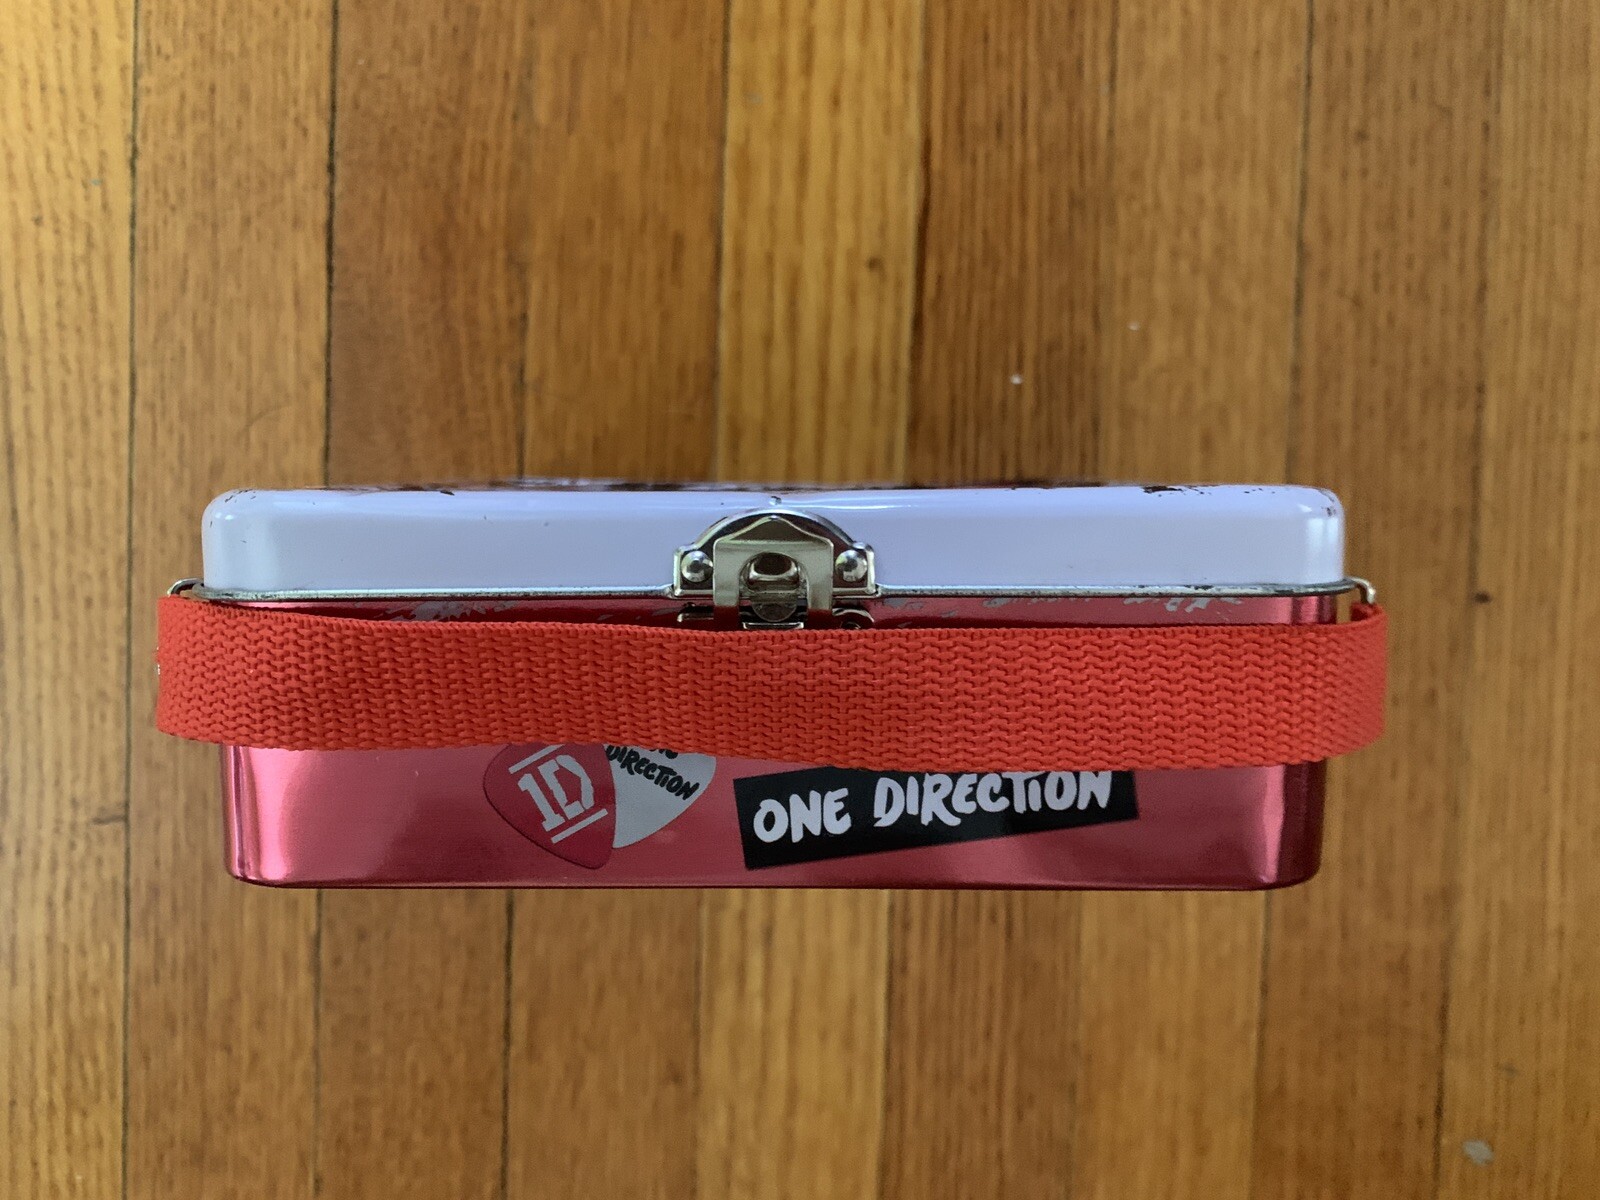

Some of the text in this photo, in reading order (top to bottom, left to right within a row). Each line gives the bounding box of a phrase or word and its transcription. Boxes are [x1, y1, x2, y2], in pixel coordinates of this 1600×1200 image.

[517, 754, 594, 832] 1D
[605, 744, 700, 801] DIRECTION
[753, 771, 1112, 843] ONE DIRECTION
